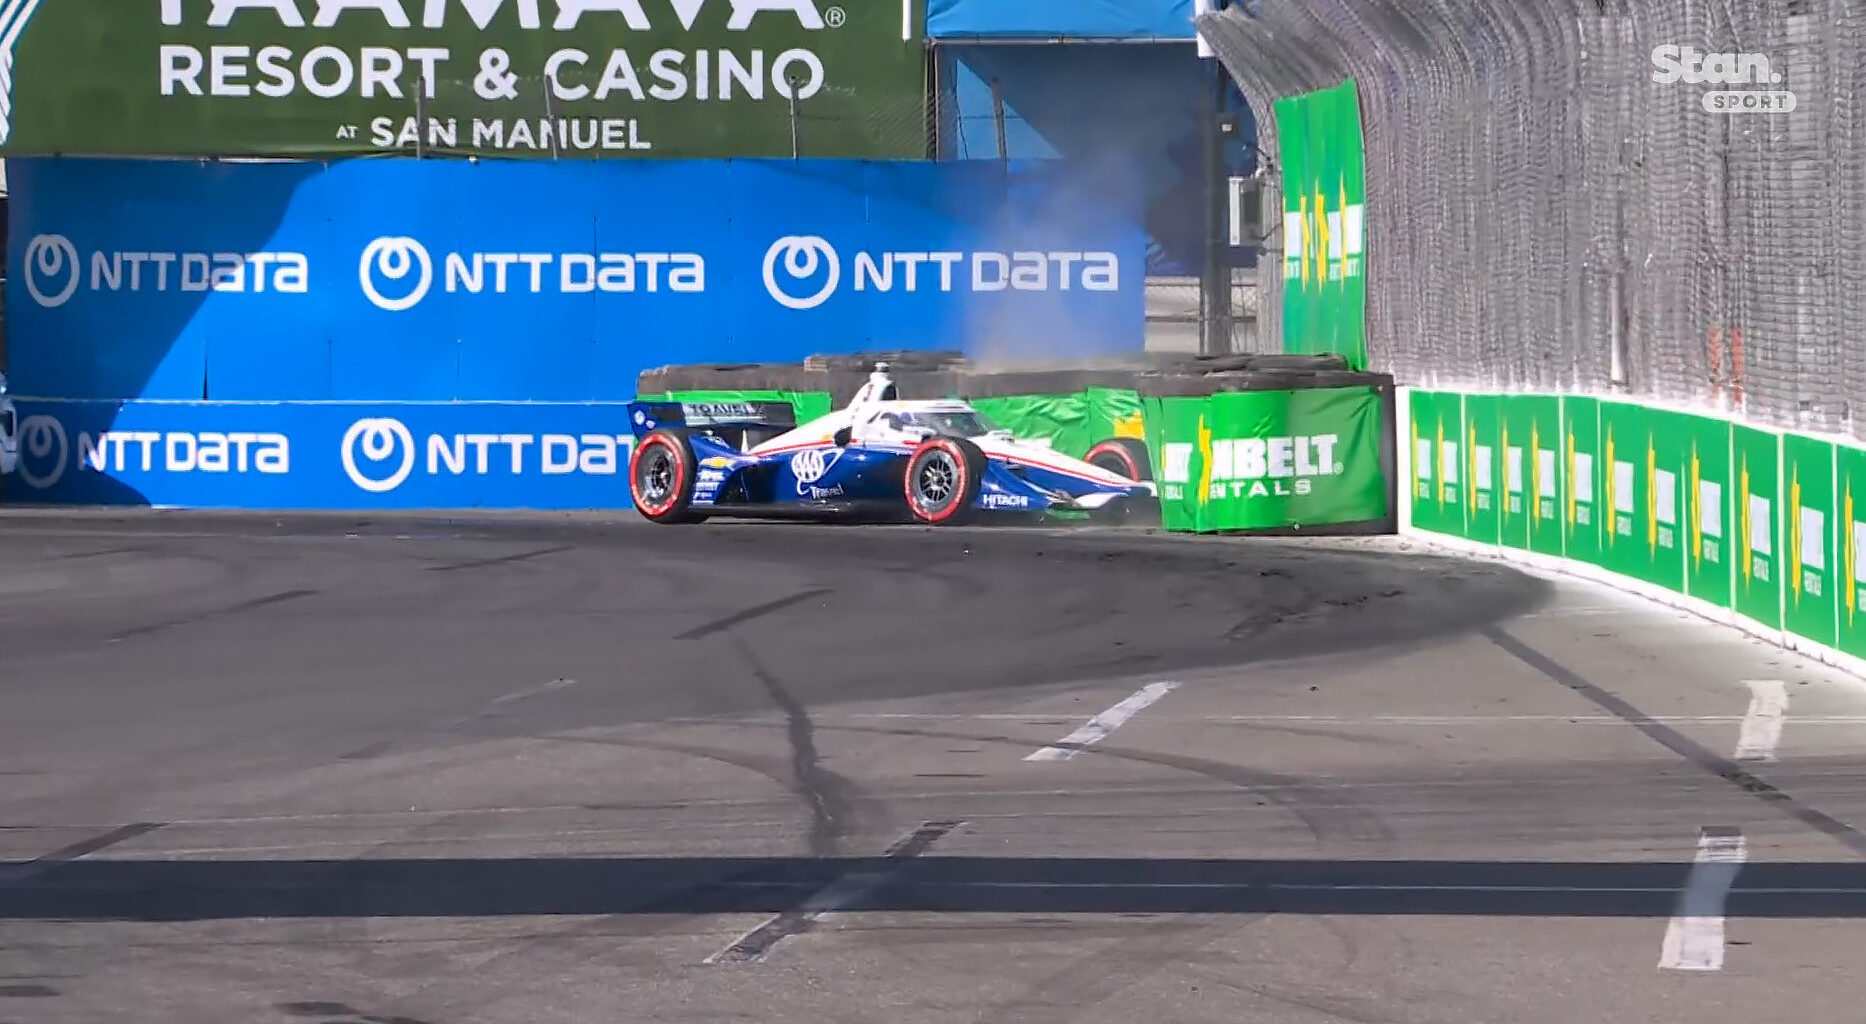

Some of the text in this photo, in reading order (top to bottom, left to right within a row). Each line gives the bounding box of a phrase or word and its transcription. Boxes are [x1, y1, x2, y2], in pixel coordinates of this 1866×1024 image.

[160, 45, 824, 100] RESORT & CASINO
[336, 116, 651, 149] AT SAN MANUEL
[91, 251, 176, 291] NTT
[446, 252, 552, 293] NTT
[854, 252, 963, 291] NTT
[78, 431, 161, 472] NTT
[427, 434, 534, 474] NTT
